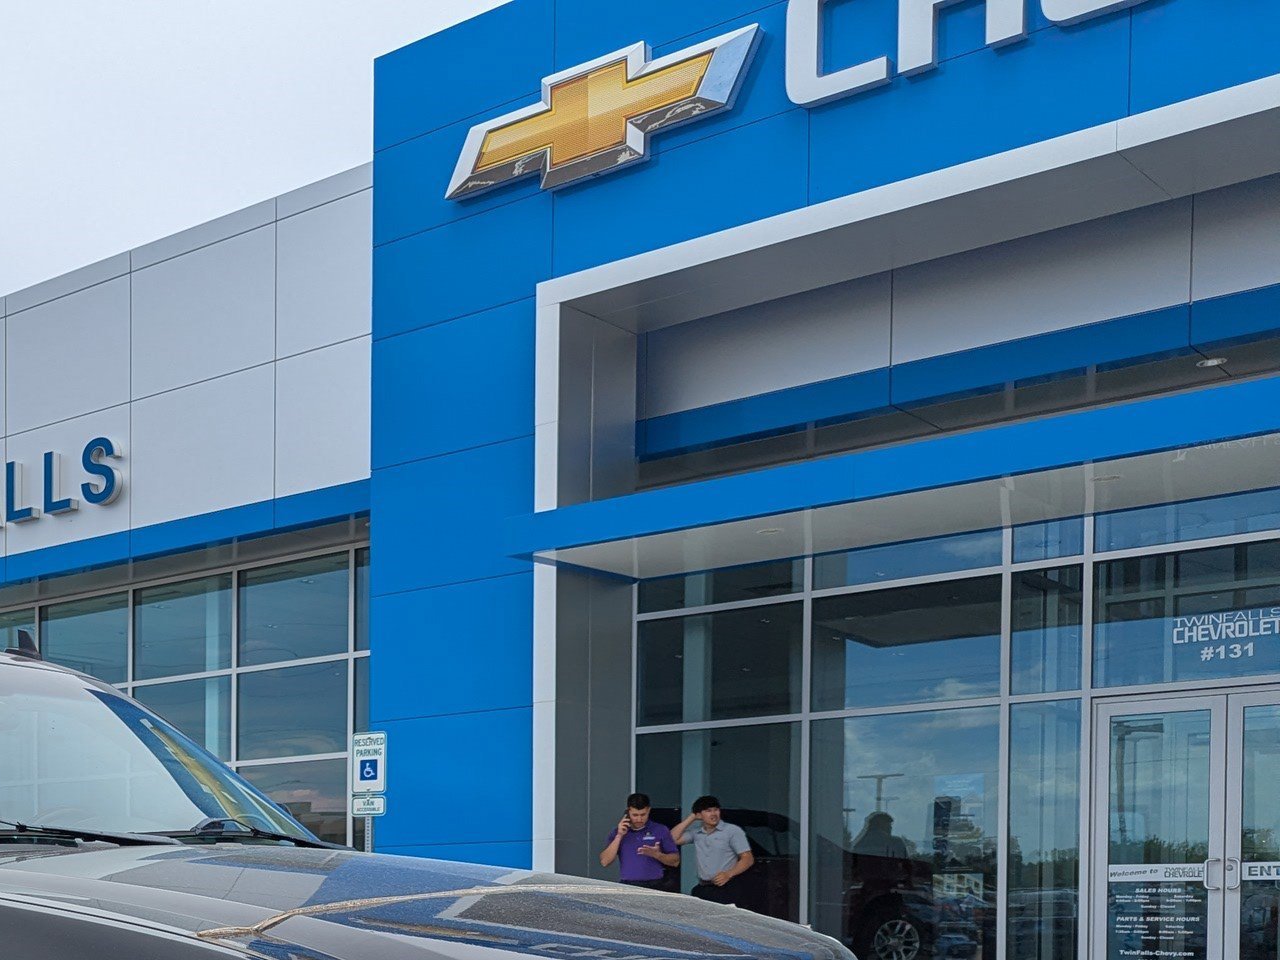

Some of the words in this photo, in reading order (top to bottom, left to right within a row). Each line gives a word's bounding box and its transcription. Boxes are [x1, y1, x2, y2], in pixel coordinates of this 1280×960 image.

[1173, 606, 1280, 628] TWINFALLS
[1173, 617, 1280, 645] CHEVROLET
[1200, 641, 1254, 661] #131
[354, 737, 384, 747] RESERVED
[356, 748, 383, 757] PARKING
[1109, 869, 1147, 878] Welcome
